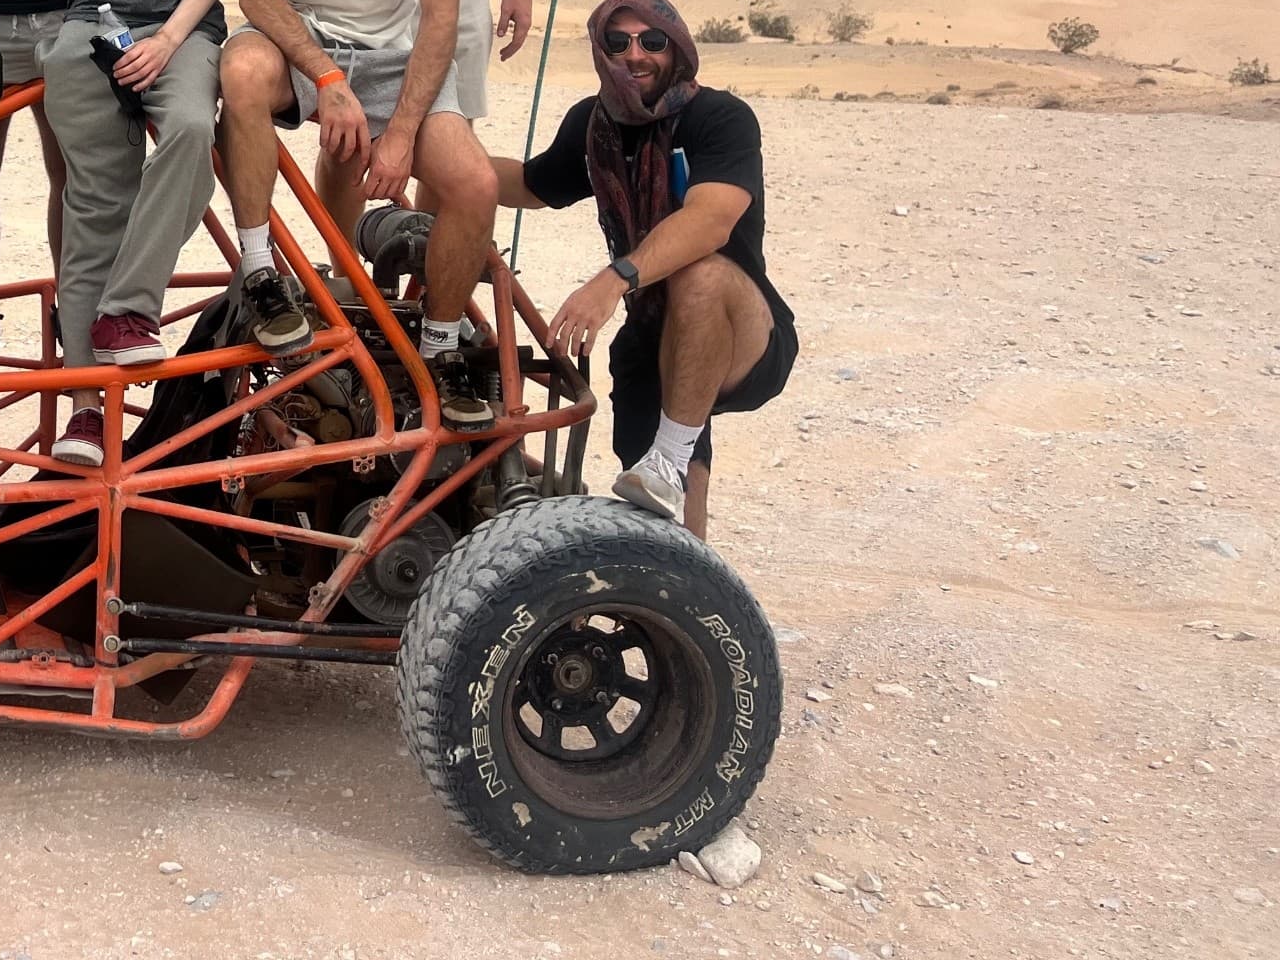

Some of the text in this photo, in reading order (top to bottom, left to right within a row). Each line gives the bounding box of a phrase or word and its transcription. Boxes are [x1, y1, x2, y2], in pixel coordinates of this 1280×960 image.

[470, 603, 537, 798] NEXEN
[674, 614, 753, 836] ROADIAN MT
